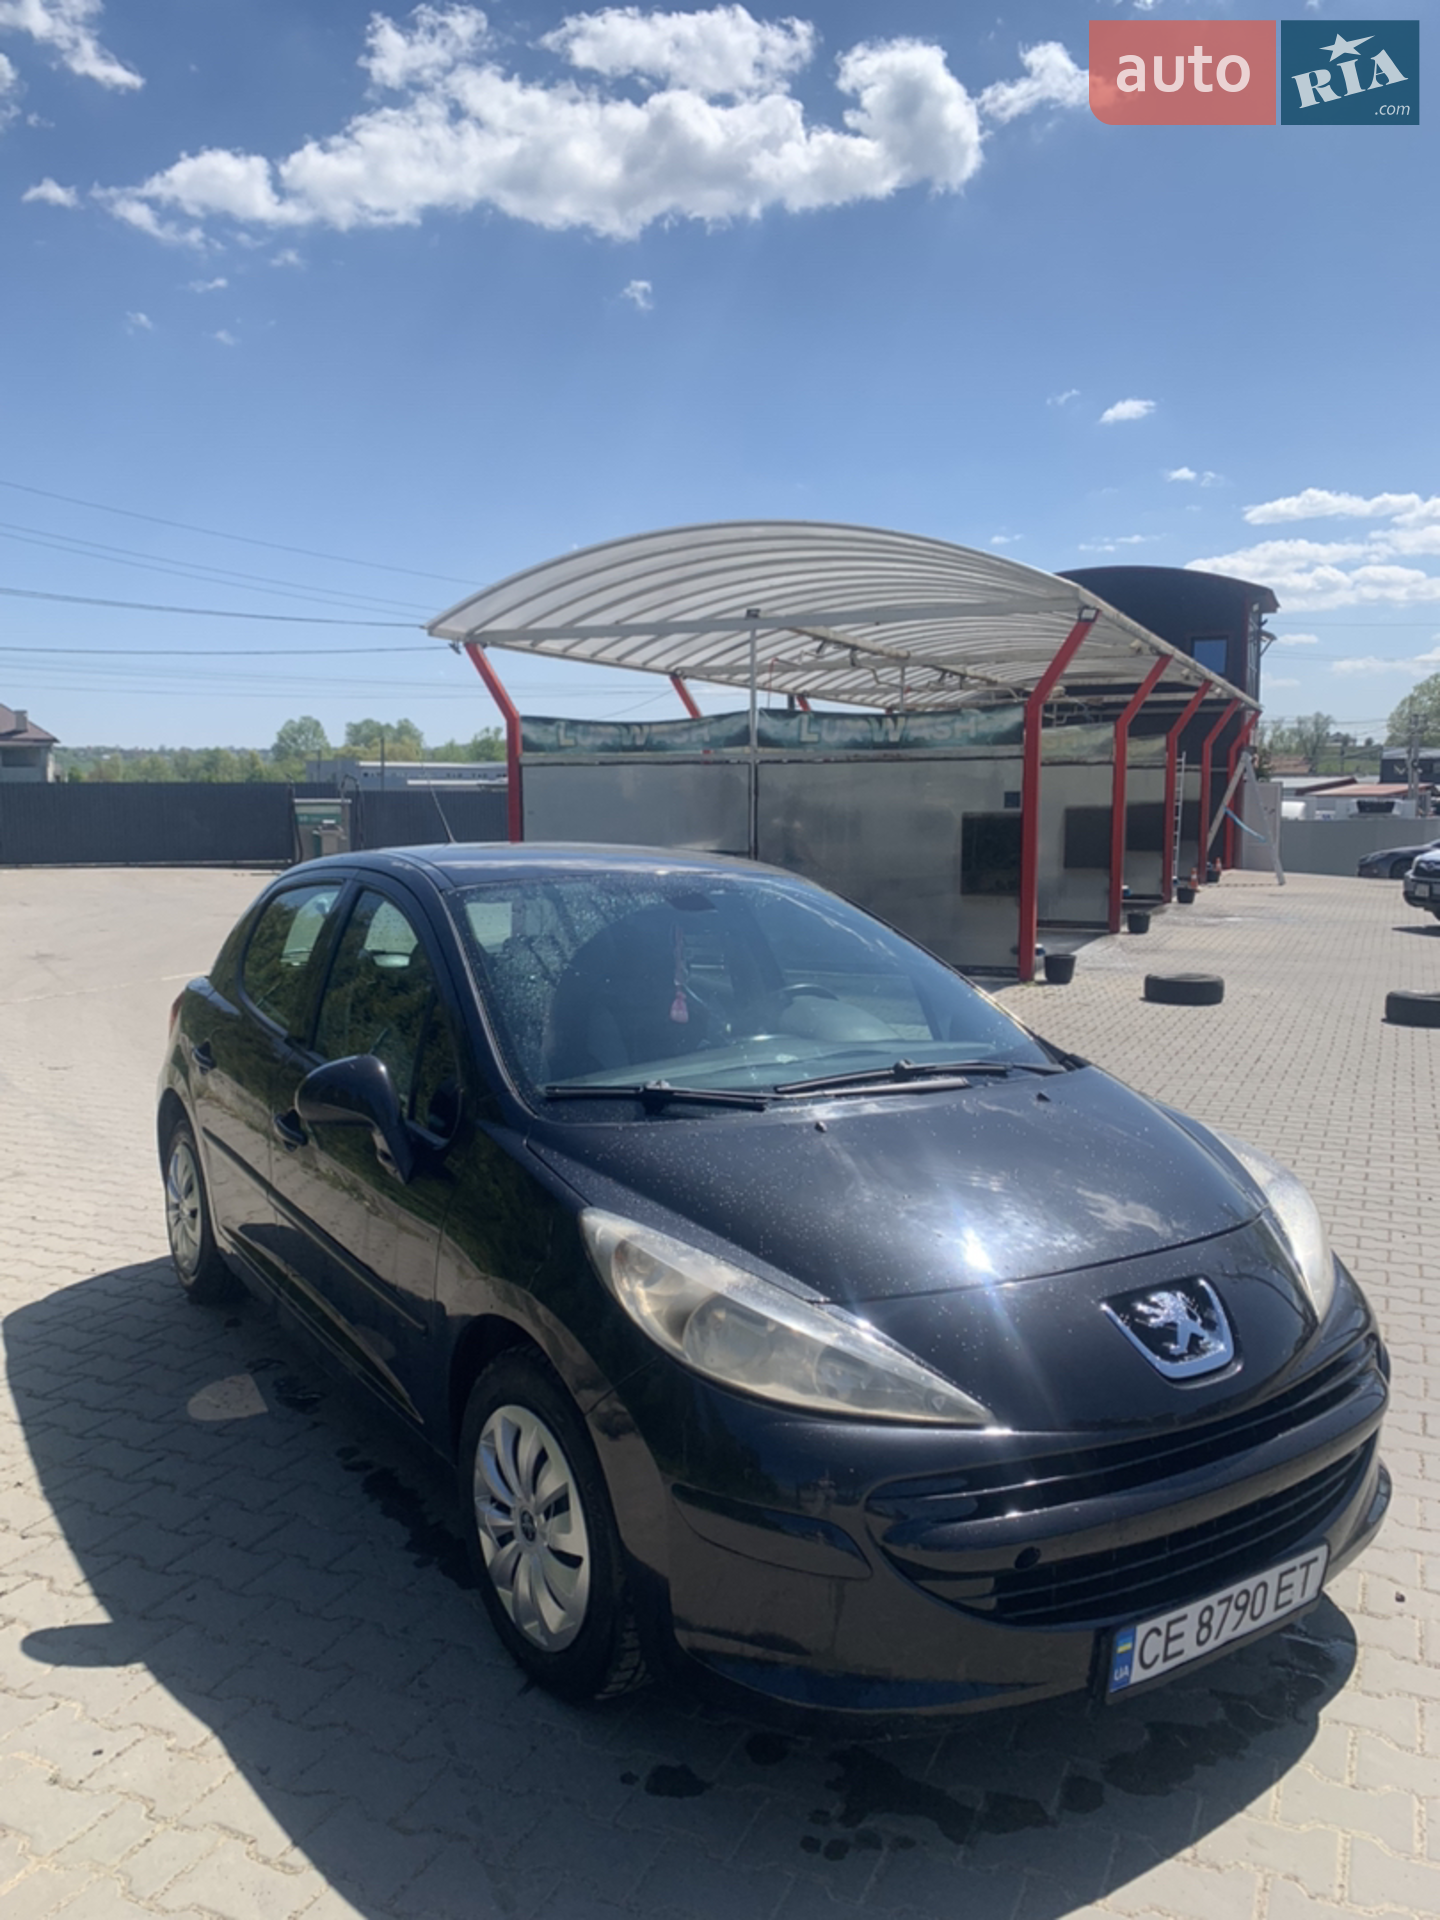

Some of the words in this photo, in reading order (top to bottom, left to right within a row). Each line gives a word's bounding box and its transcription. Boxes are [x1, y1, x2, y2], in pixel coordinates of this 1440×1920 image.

[1138, 1614, 1189, 1671] CE
[1195, 1581, 1269, 1647] 8790
[1274, 1556, 1320, 1612] ET
[1113, 1665, 1130, 1682] UA
